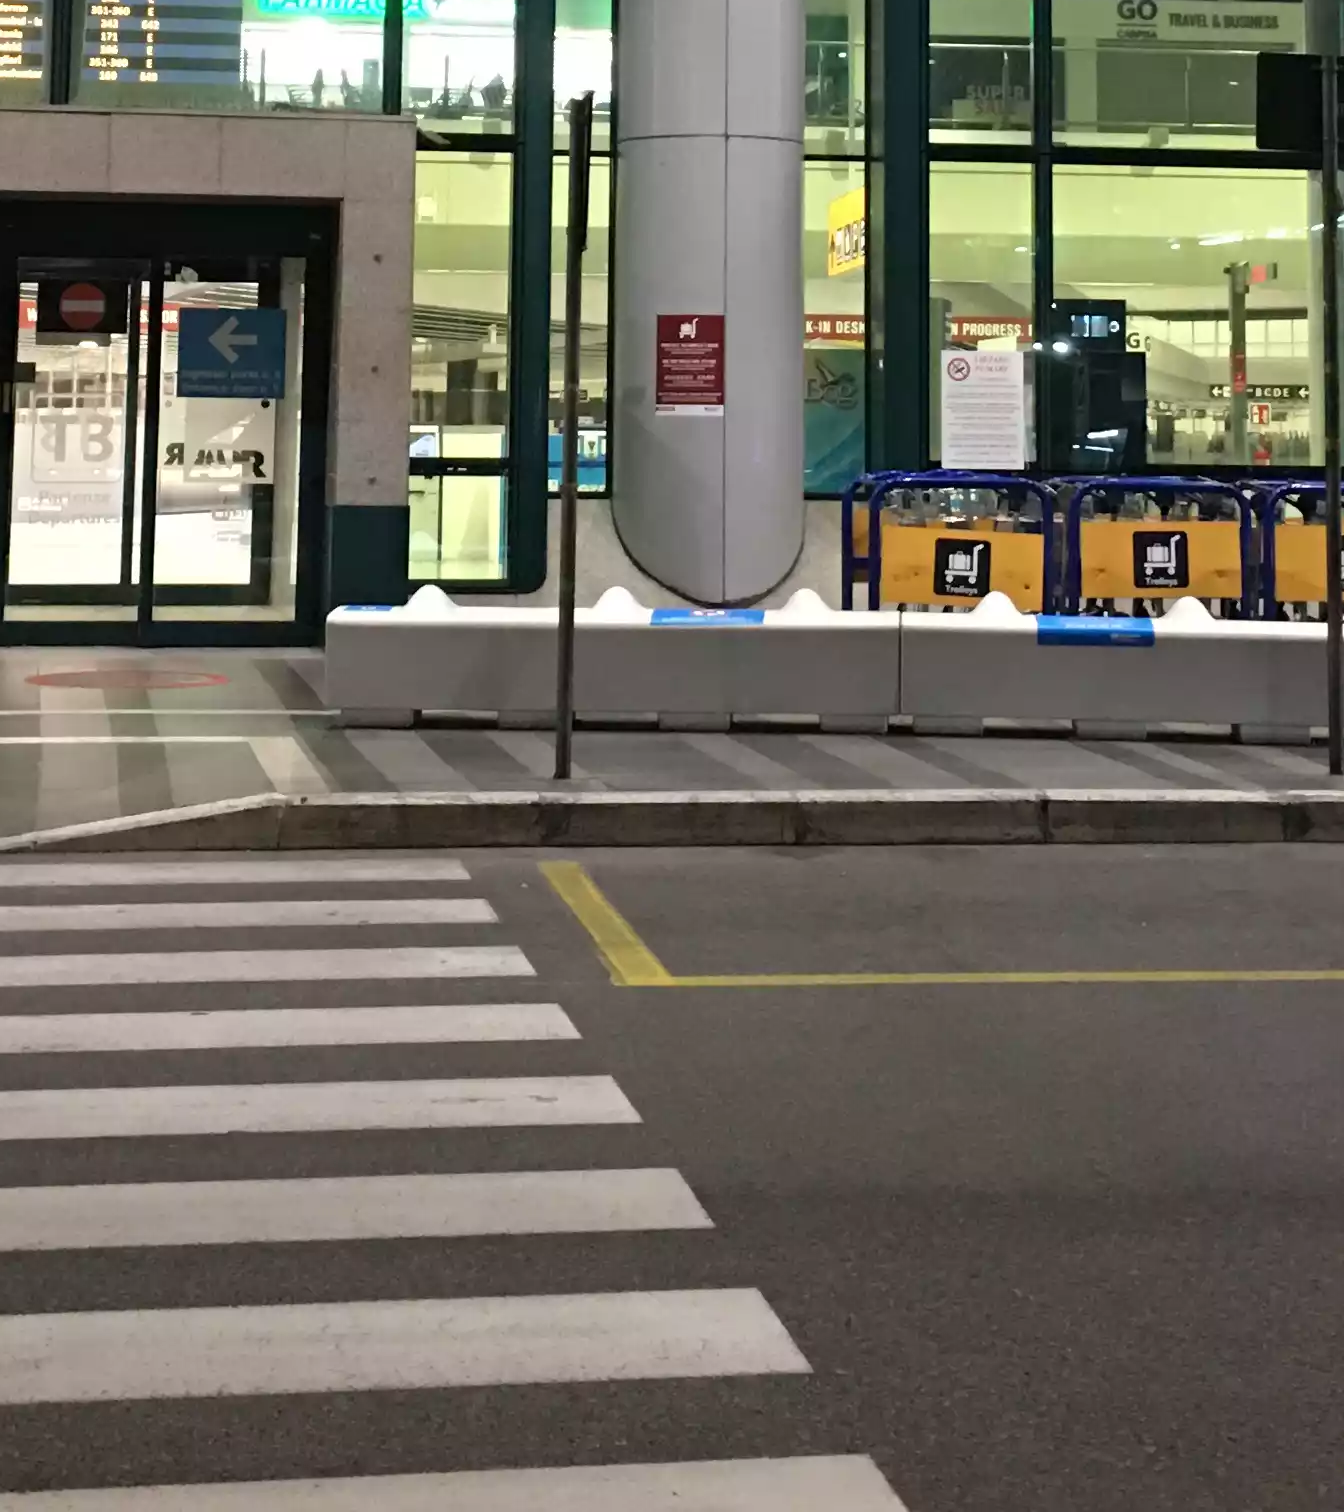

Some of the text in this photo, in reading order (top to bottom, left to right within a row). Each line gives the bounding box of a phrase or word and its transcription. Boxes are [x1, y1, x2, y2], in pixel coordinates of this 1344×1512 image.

[91, 6, 130, 16] 351-360
[1168, 12, 1208, 29] TRAVEL
[1223, 14, 1280, 30] BUSINESS
[101, 32, 118, 41] 171
[962, 322, 1025, 338] PROGRESS.
[1145, 576, 1178, 587] Trolleys
[944, 583, 979, 595] Trolleys
